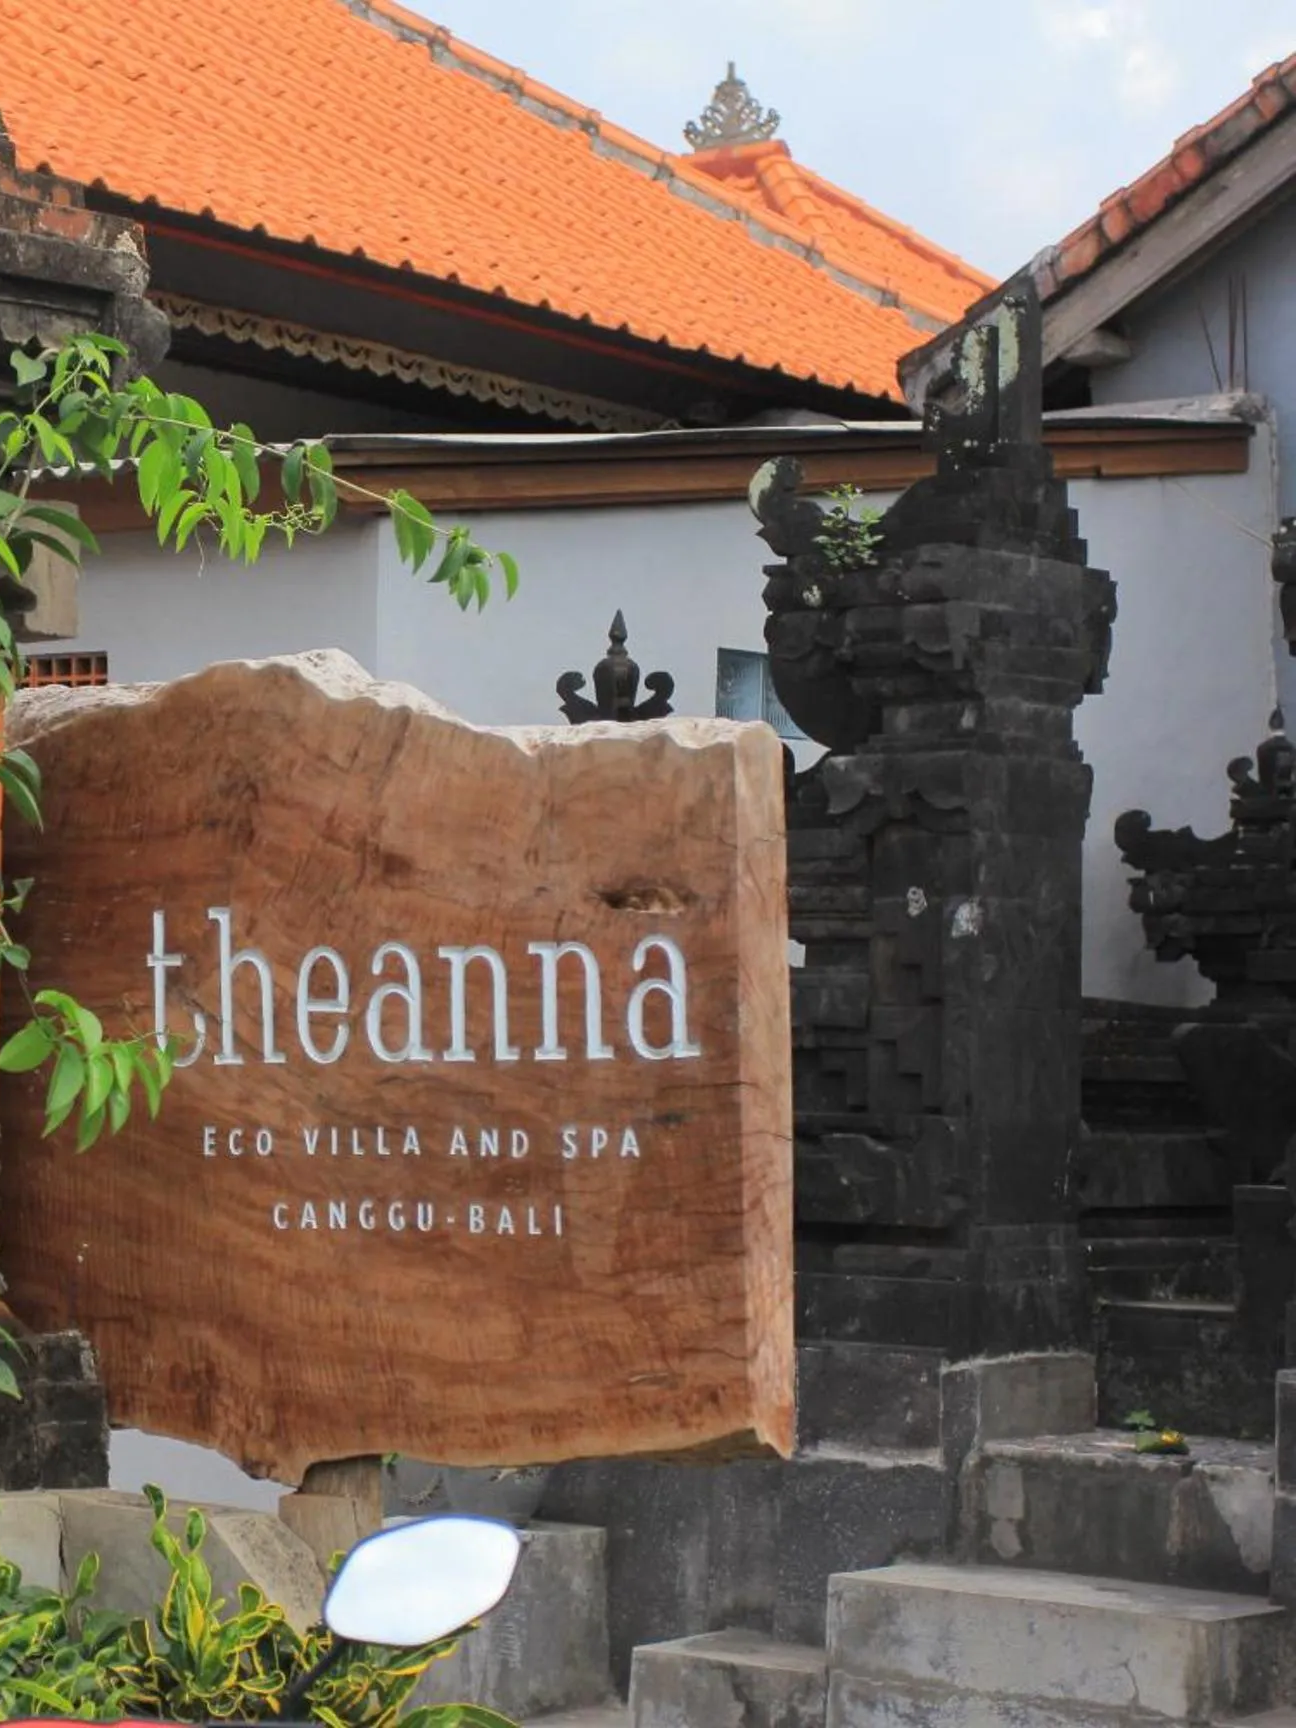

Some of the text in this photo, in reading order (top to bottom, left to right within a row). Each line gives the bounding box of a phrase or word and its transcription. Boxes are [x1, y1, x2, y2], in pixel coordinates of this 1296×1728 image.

[146, 906, 701, 1067] theanna
[203, 1126, 642, 1160] ECO VILLA AND SPA
